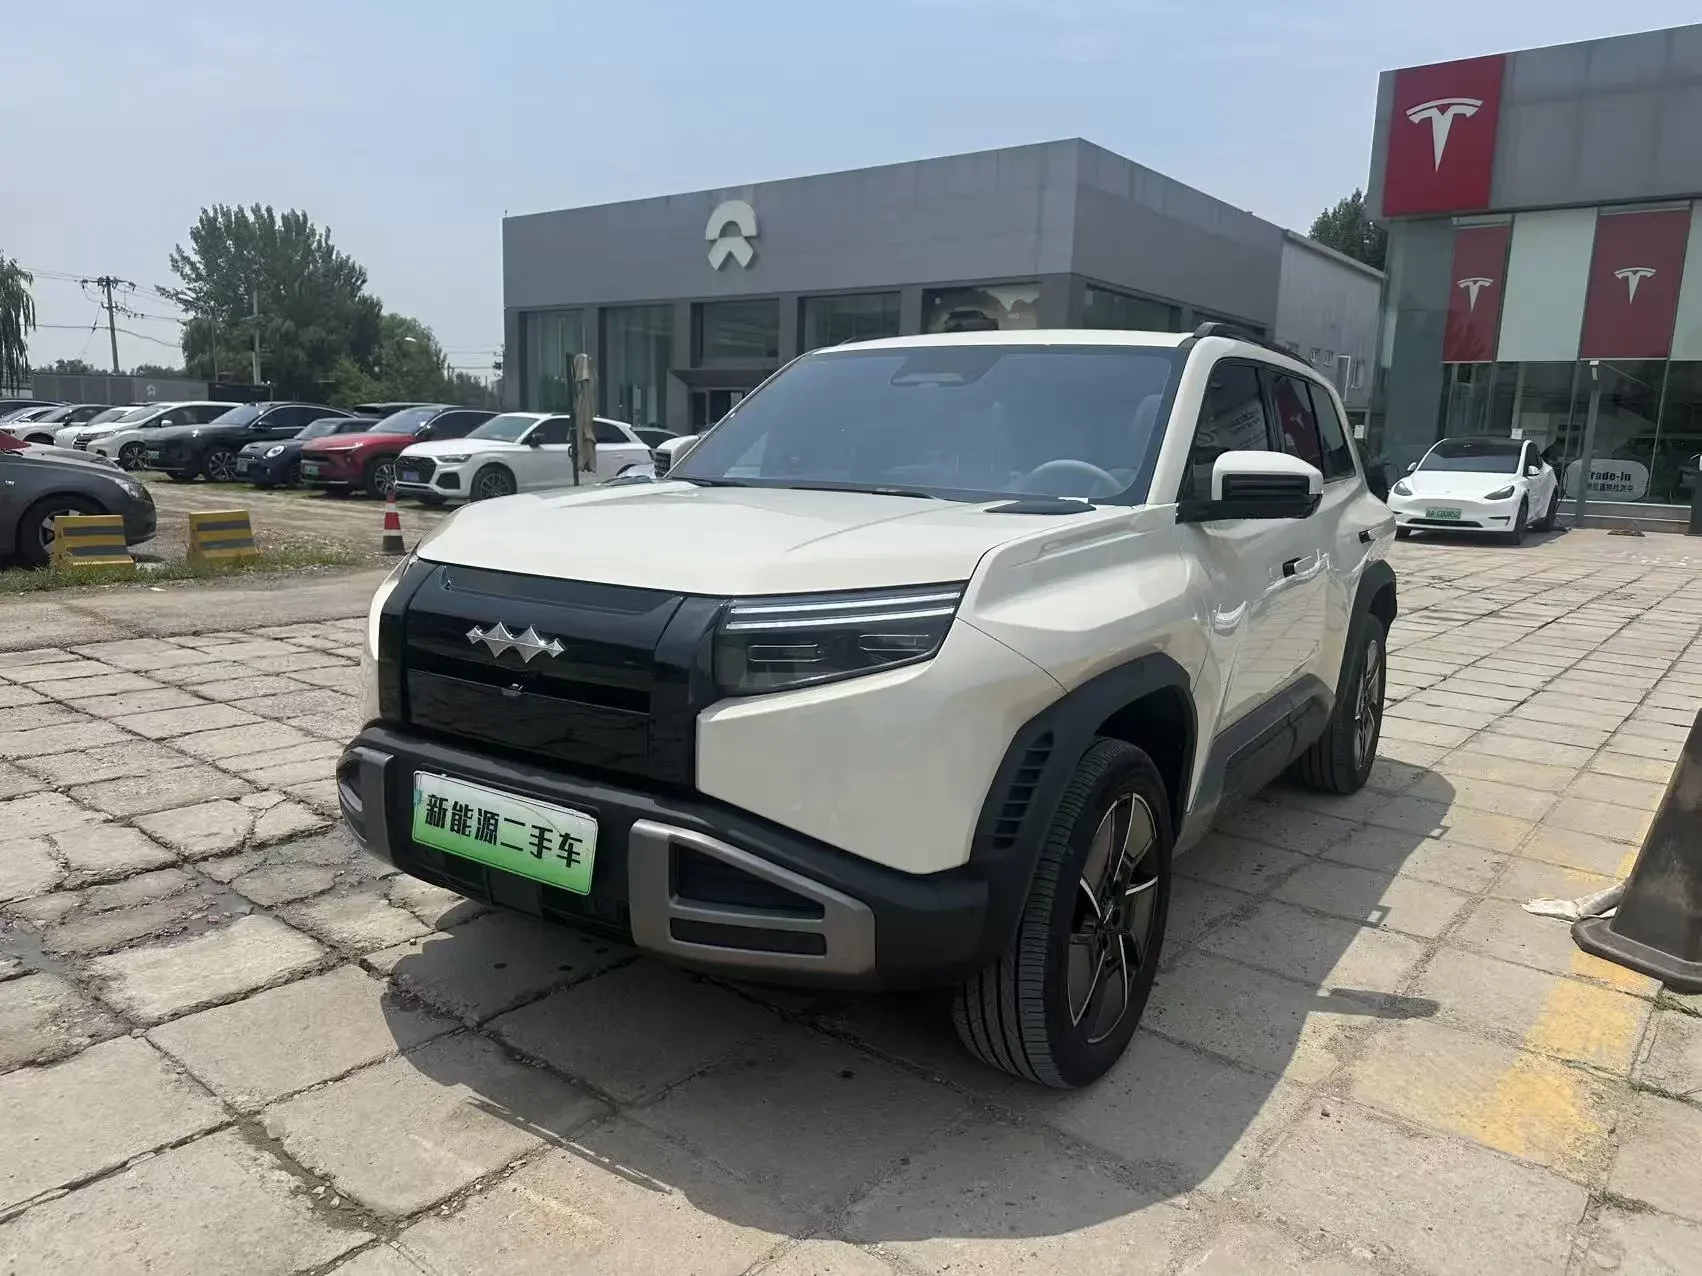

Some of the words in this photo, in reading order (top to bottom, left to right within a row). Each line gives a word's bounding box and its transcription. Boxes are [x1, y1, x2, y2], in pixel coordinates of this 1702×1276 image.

[1588, 471, 1632, 481] rade-In
[425, 793, 583, 868] 新能源二手车
